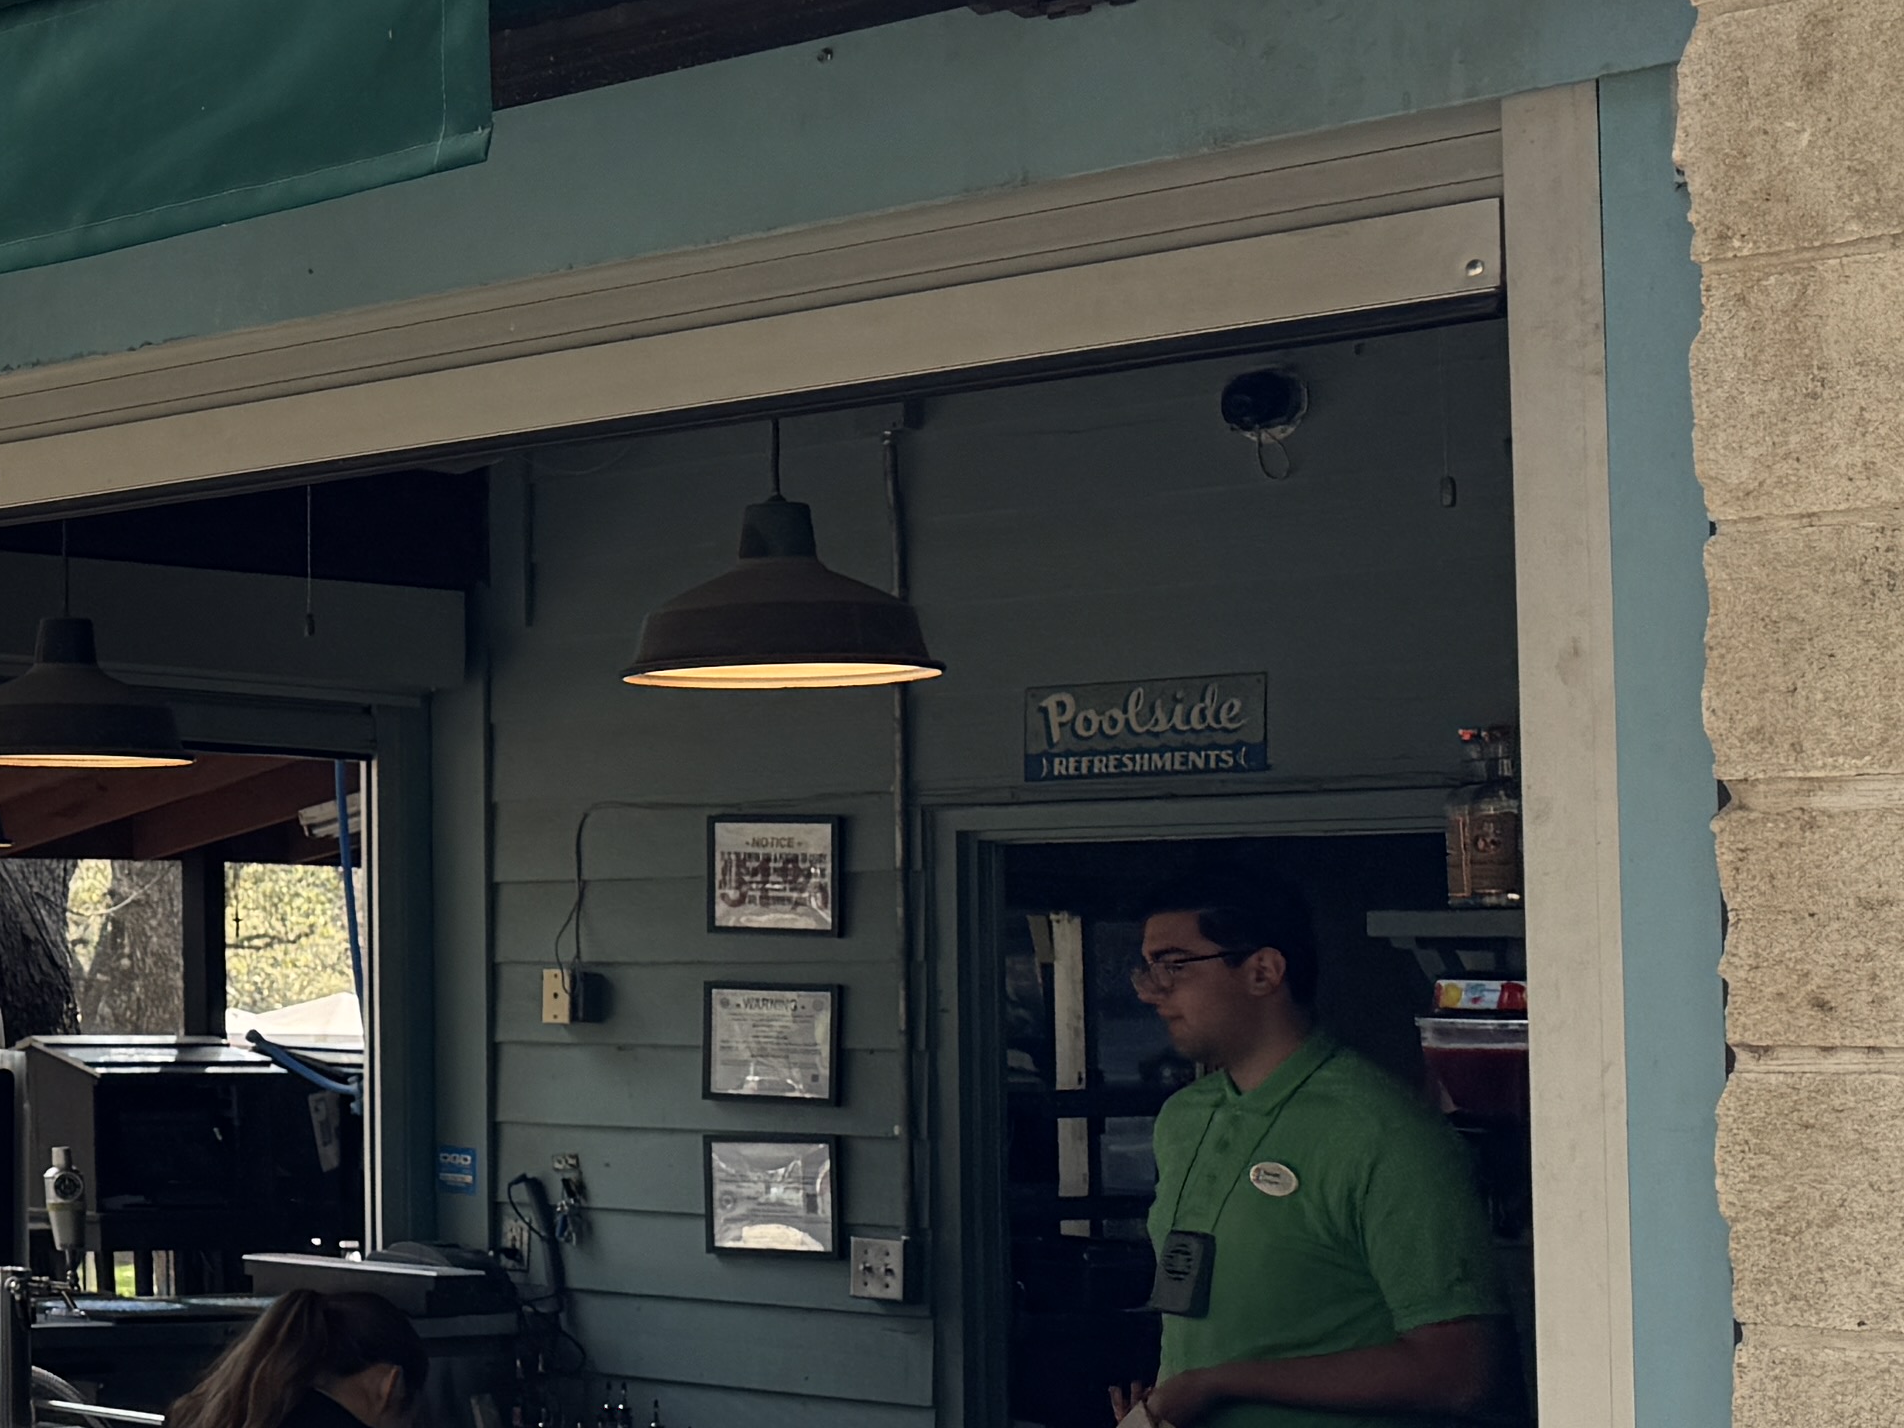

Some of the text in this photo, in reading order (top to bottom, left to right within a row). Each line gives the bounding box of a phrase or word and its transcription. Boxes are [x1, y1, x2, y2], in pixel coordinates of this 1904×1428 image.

[1039, 683, 1250, 744] Poolside
[1052, 748, 1235, 777] REFRESHMENTS
[751, 836, 795, 849] NOTICE
[742, 996, 798, 1012] WARNING
